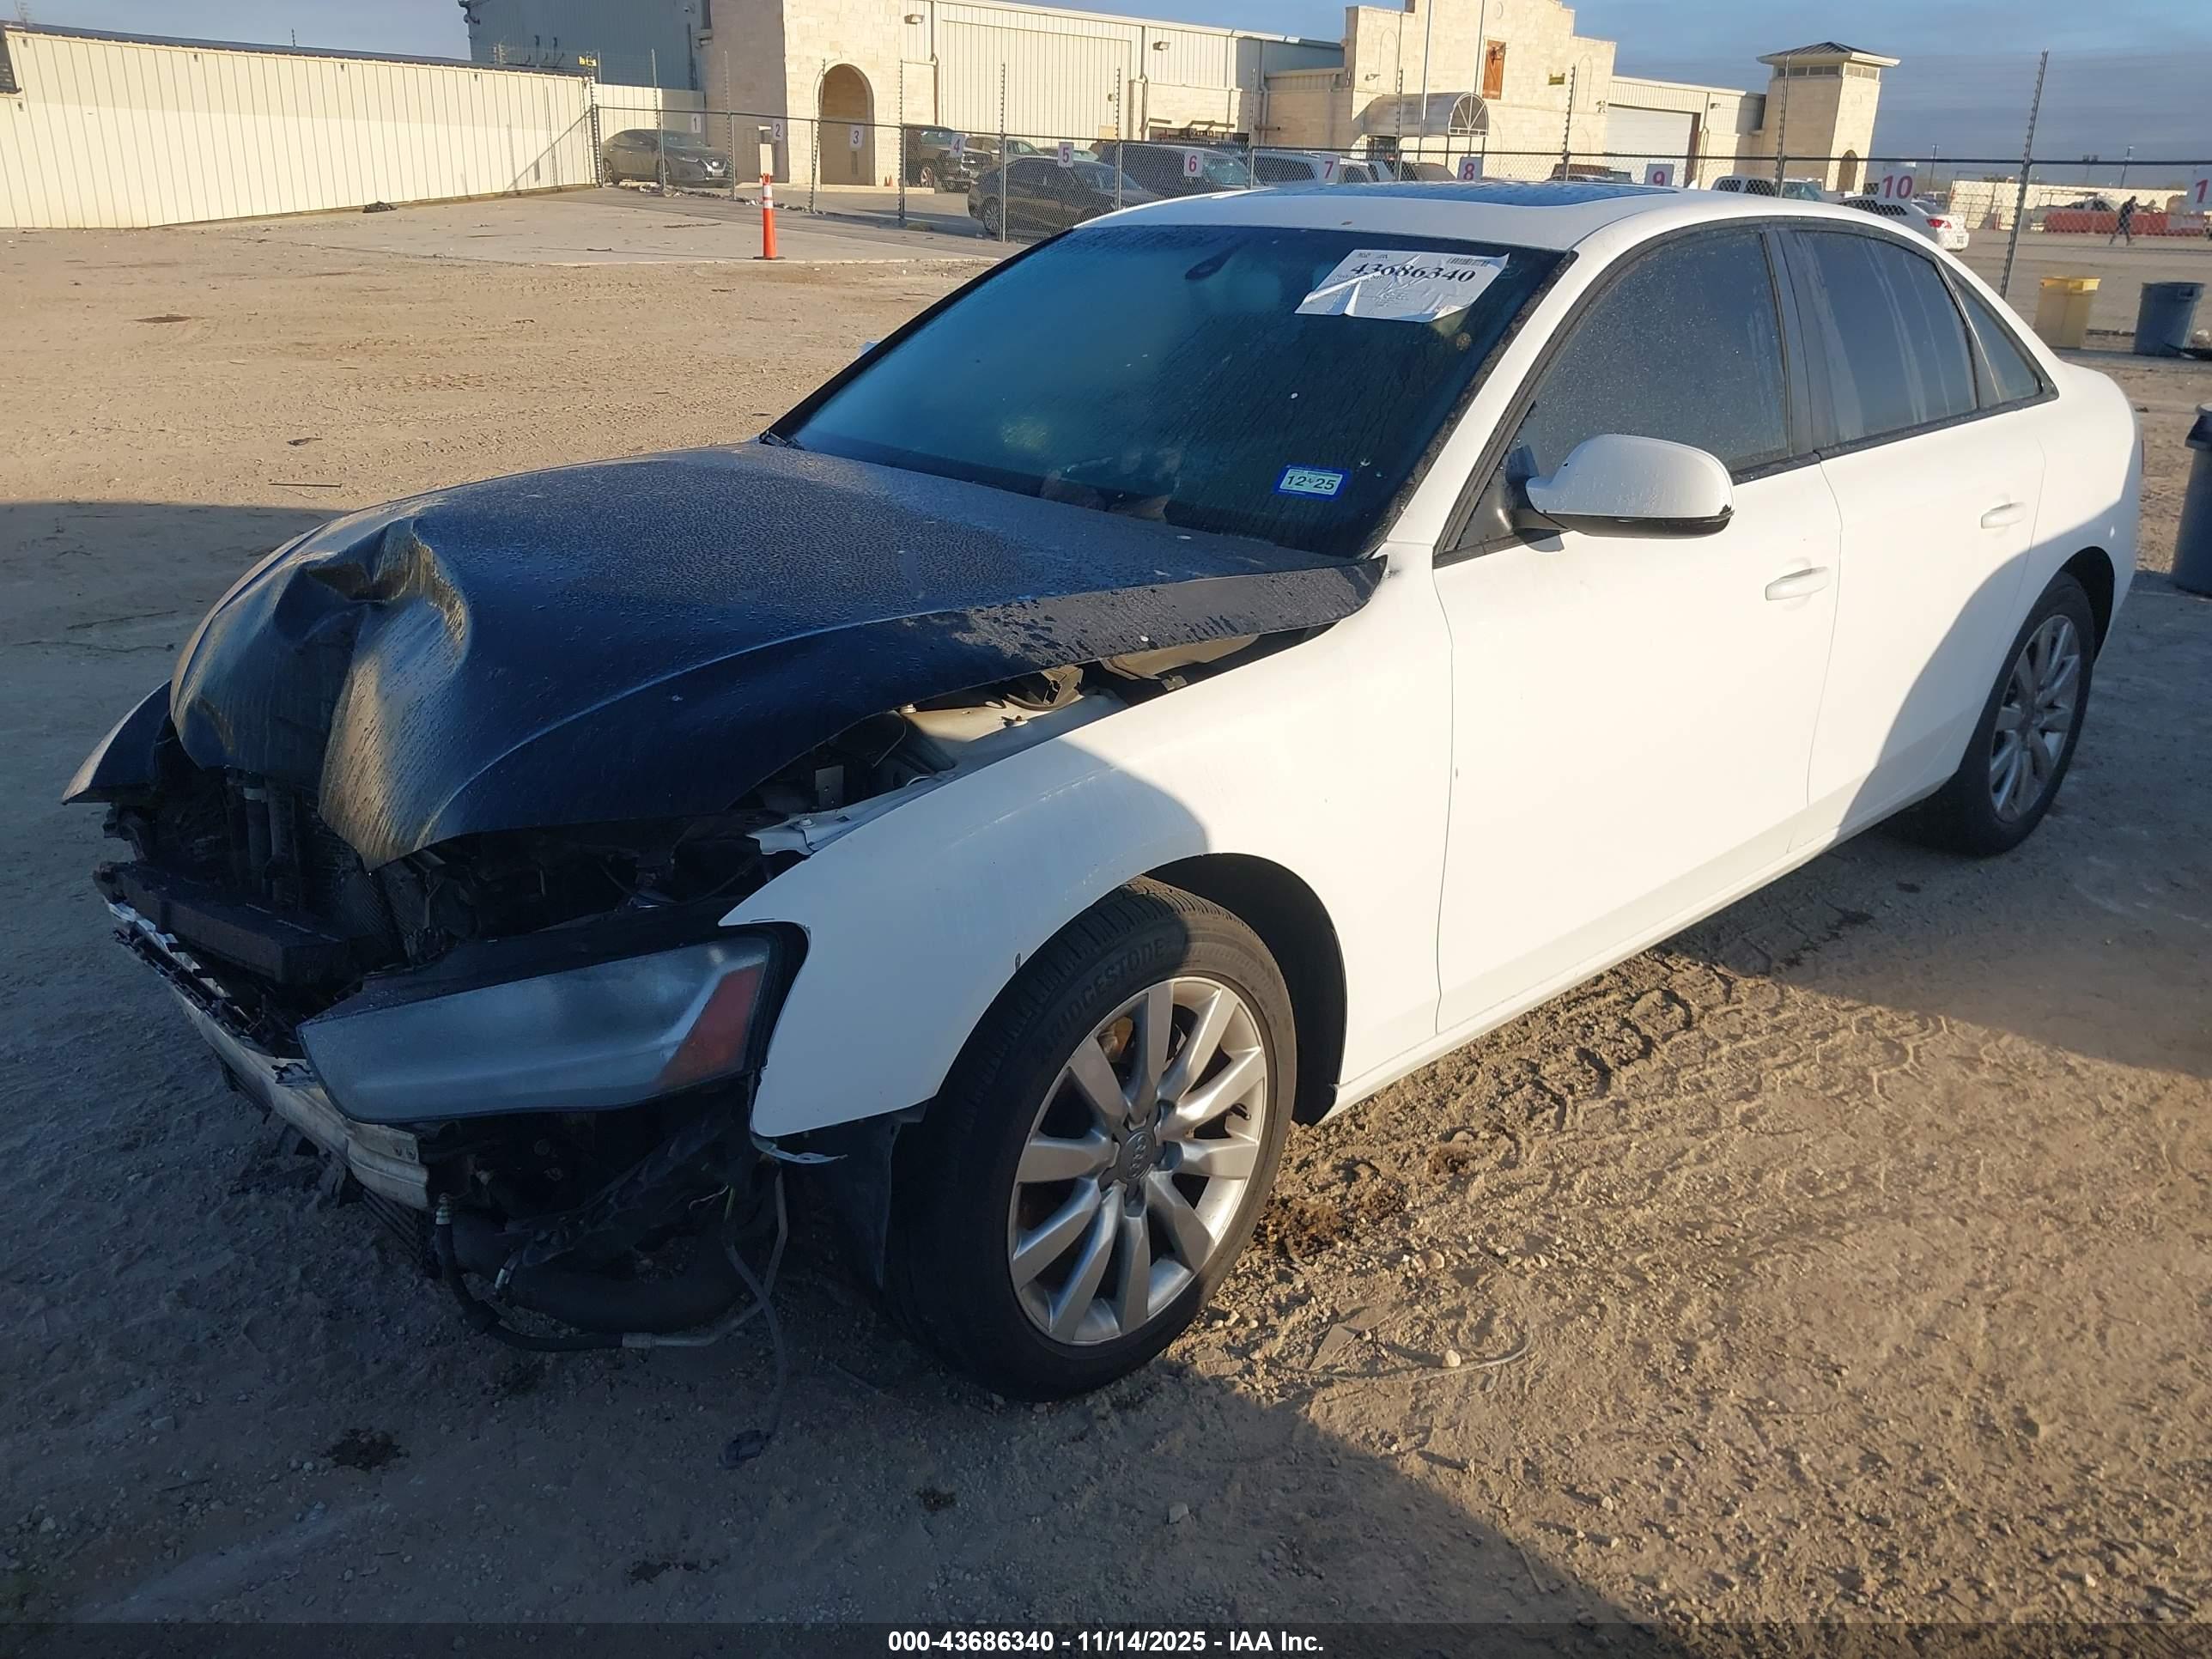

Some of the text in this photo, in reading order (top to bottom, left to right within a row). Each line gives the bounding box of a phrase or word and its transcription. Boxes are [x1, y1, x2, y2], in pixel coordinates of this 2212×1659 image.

[775, 123, 781, 137] 2
[853, 130, 860, 144] 3
[952, 137, 960, 153] 4
[1062, 148, 1070, 162] 5
[1188, 155, 1197, 172] 6
[1323, 161, 1334, 179] 7
[1463, 163, 1474, 180] 8
[1652, 171, 1665, 186] 9
[1882, 175, 1913, 199] 10
[1030, 938, 1166, 1063] RIDGESTONE
